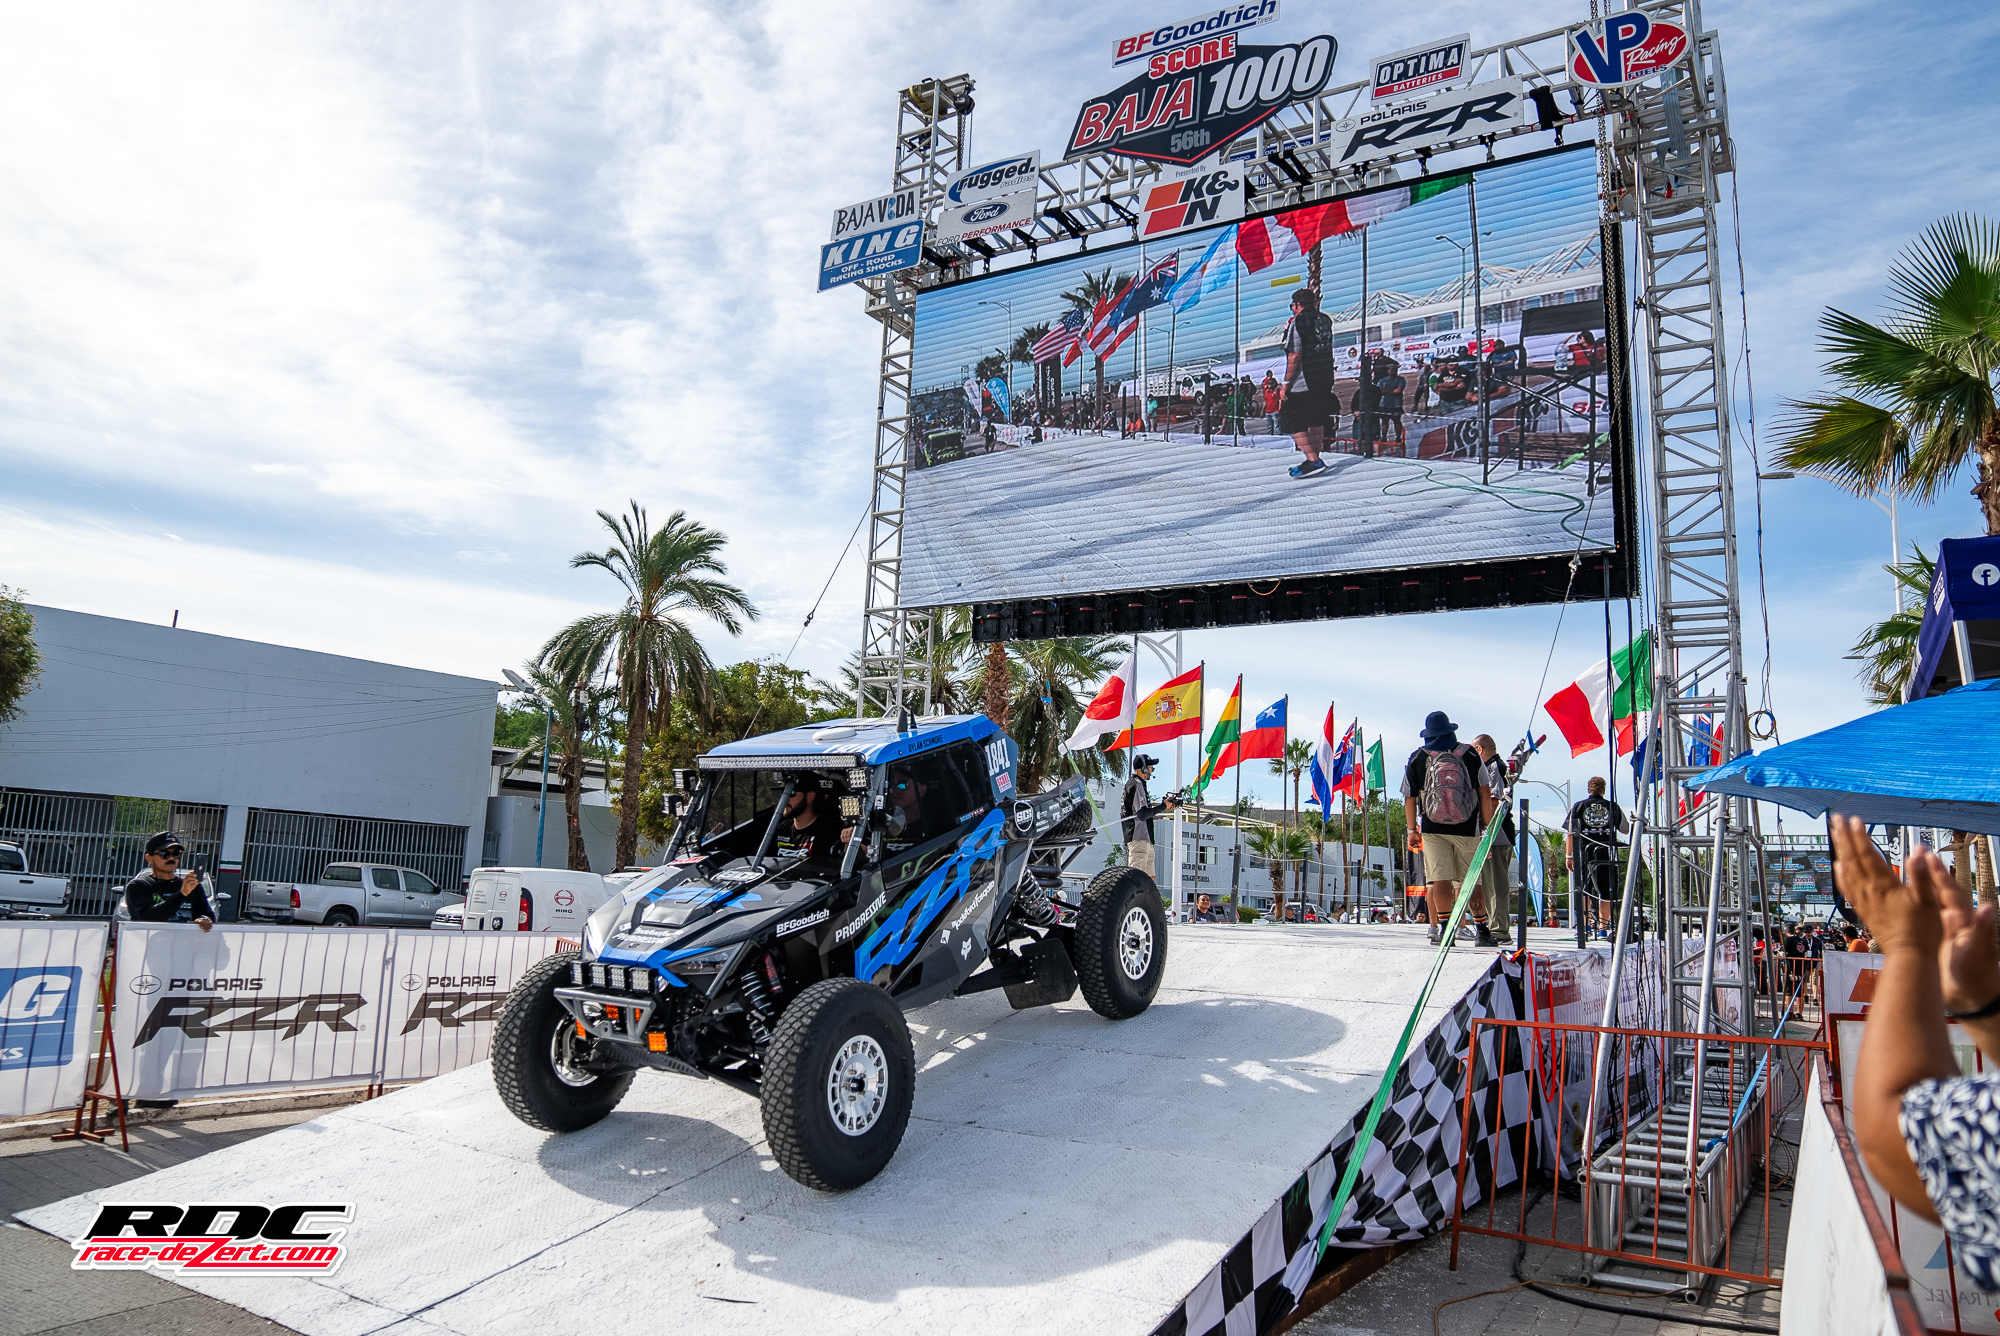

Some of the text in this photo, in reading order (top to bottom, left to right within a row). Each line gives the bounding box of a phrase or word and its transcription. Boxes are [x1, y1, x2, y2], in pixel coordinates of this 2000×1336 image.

[1117, 0, 1276, 58] BFGoodrich
[1257, 15, 1273, 25] Tires
[1149, 34, 1236, 79] SCORE
[1575, 13, 1649, 83] VP
[1626, 34, 1686, 72] Racing
[1379, 46, 1460, 84] OPTIMA
[1628, 64, 1668, 79] FUELS
[1072, 38, 1332, 150] BAJA 1000
[1392, 72, 1444, 92] BATTERIES
[1339, 91, 1517, 162] RZR
[1360, 101, 1427, 126] POLARIS
[1170, 128, 1211, 153] 56th
[1175, 165, 1207, 178] Presented By
[836, 202, 875, 235] BAJA
[971, 205, 1000, 221] Ford
[824, 225, 920, 268] KING
[937, 217, 1031, 246] FORD PERFORMANCE
[830, 268, 864, 283] RACING
[841, 263, 859, 273] OFF
[866, 254, 895, 266] ROAD
[985, 738, 1010, 776] 1841
[776, 908, 830, 935] BFGoodrich
[836, 891, 887, 943] PROGRESSIVE
[169, 978, 263, 991] POLARIS
[428, 976, 496, 987] POLARIS
[132, 993, 368, 1049] RZR
[400, 992, 511, 1036] RZ
